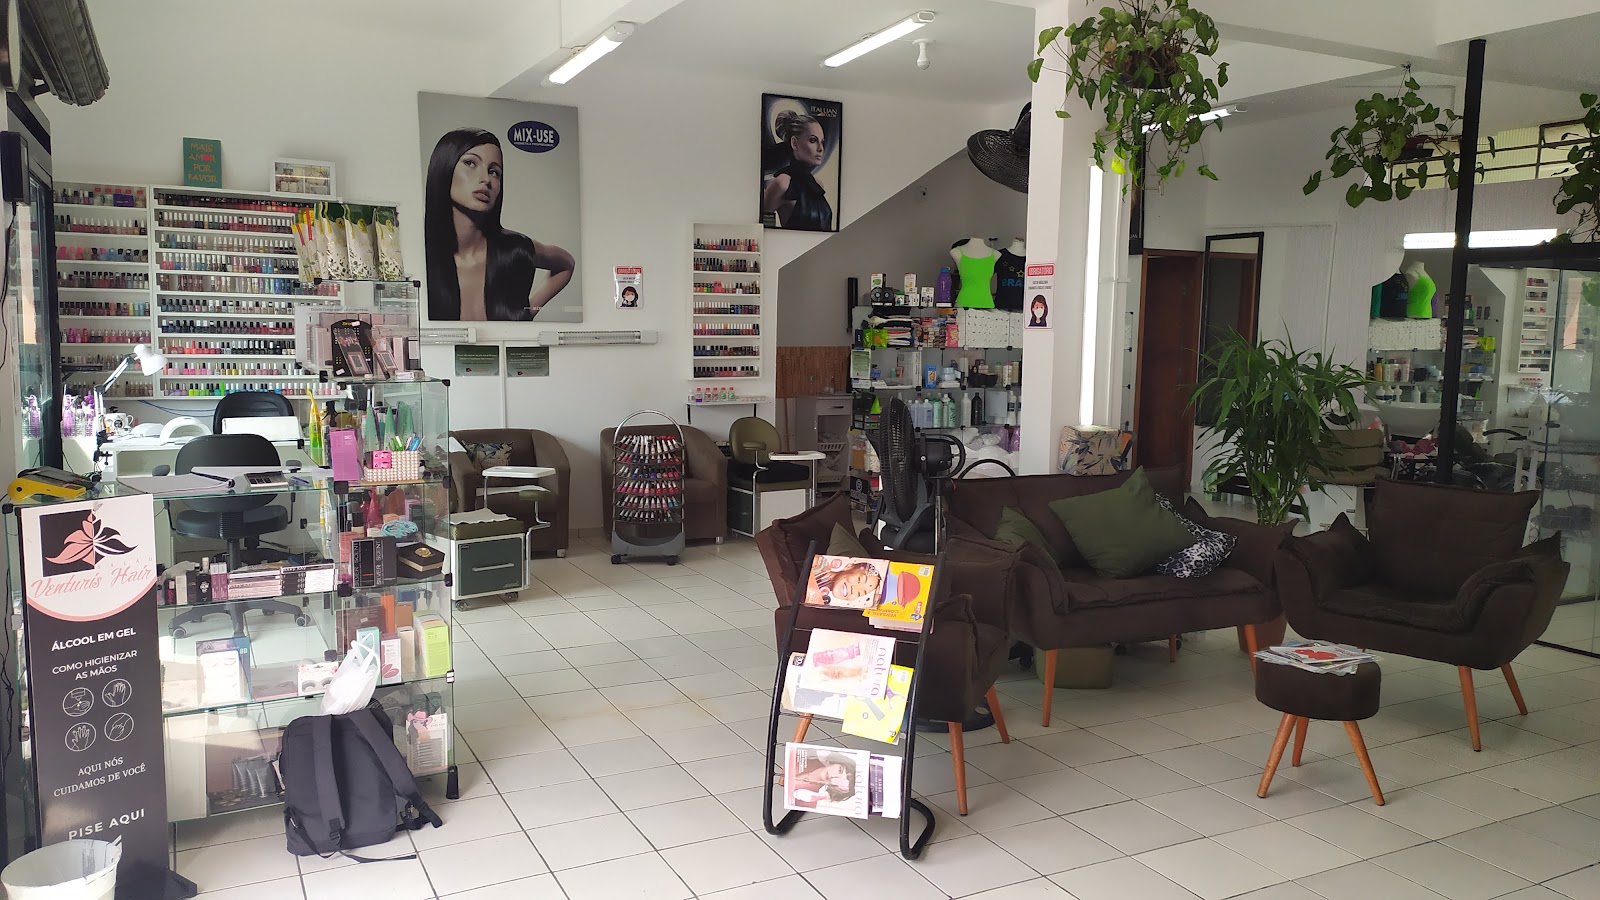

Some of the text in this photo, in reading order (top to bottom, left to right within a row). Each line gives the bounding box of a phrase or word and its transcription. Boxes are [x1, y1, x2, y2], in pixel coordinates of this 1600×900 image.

[811, 106, 837, 114] ITALLIAN
[513, 127, 554, 144] MIX-USE
[190, 143, 213, 153] MAIS
[193, 163, 212, 172] POR
[187, 173, 218, 184] FAVOR
[31, 563, 153, 599] Venturis Hair
[51, 627, 137, 652] ÁLCOOL EM GEL
[52, 649, 138, 675] COMO HIGIENIZAR
[75, 664, 118, 681] AS MÃOS
[870, 646, 888, 696] natura
[77, 756, 124, 777] AQUI NÓS
[53, 762, 147, 797] CUIDAMOS DE VOCÊ
[68, 808, 145, 841] PISE AQUI
